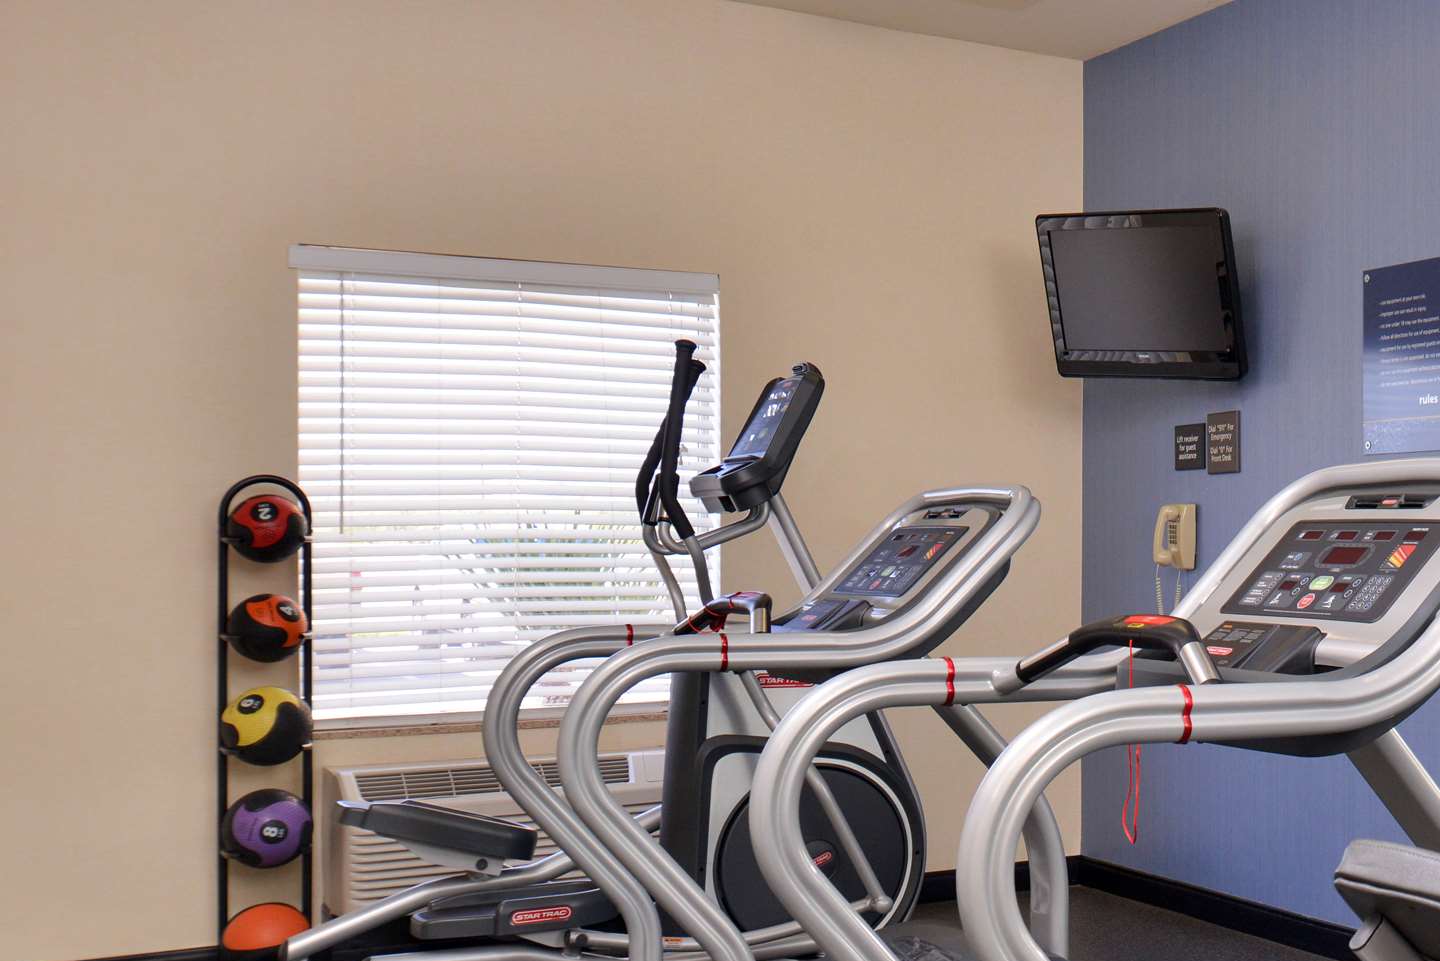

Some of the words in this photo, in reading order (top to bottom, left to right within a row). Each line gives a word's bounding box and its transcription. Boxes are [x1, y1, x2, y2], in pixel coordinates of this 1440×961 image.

[1419, 393, 1438, 406] rules
[258, 507, 272, 520] 2
[279, 606, 292, 616] 4
[263, 826, 278, 837] 8
[515, 912, 541, 921] STAR
[542, 909, 568, 918] TRAC
